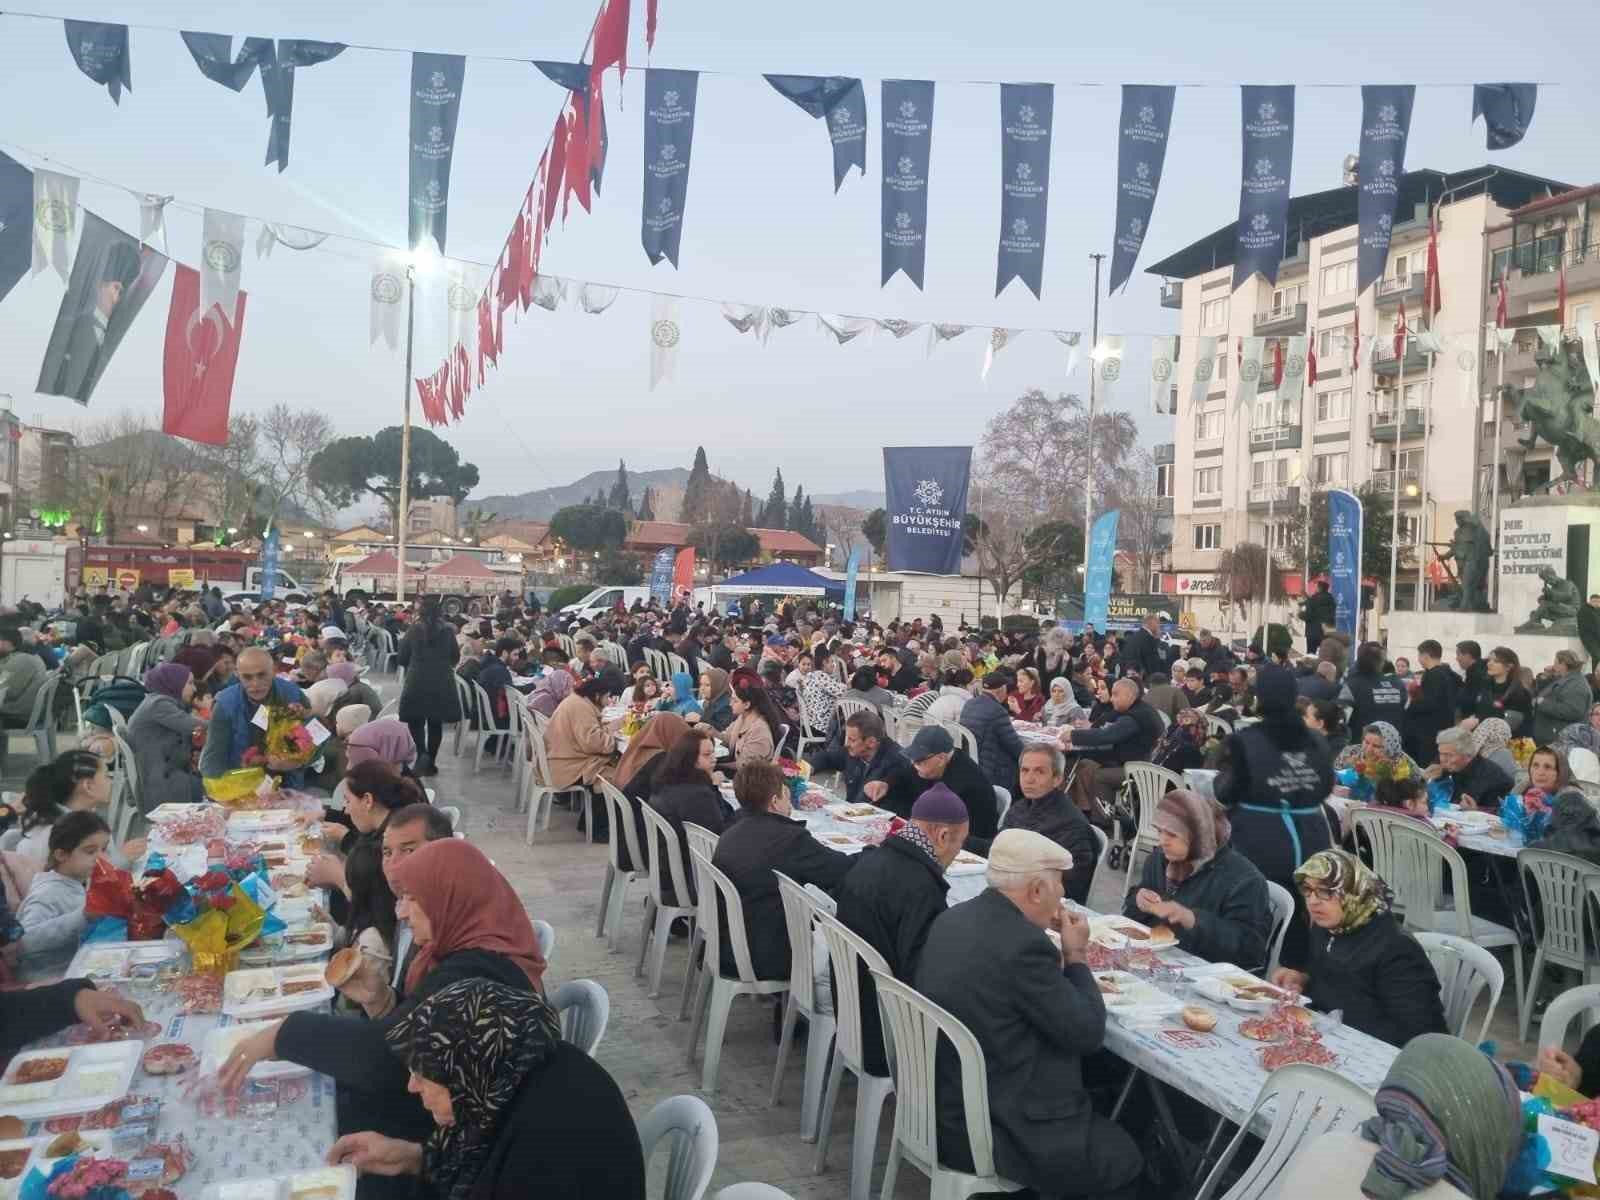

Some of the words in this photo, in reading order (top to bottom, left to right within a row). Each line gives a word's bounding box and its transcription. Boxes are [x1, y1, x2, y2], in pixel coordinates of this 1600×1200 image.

[925, 508, 950, 516] AYDIN
[892, 513, 961, 529] BÜYÜKŞEHİR
[1503, 519, 1523, 530] NE
[1503, 533, 1552, 545] MUTLU
[1502, 545, 1563, 560] TÜRKÜM
